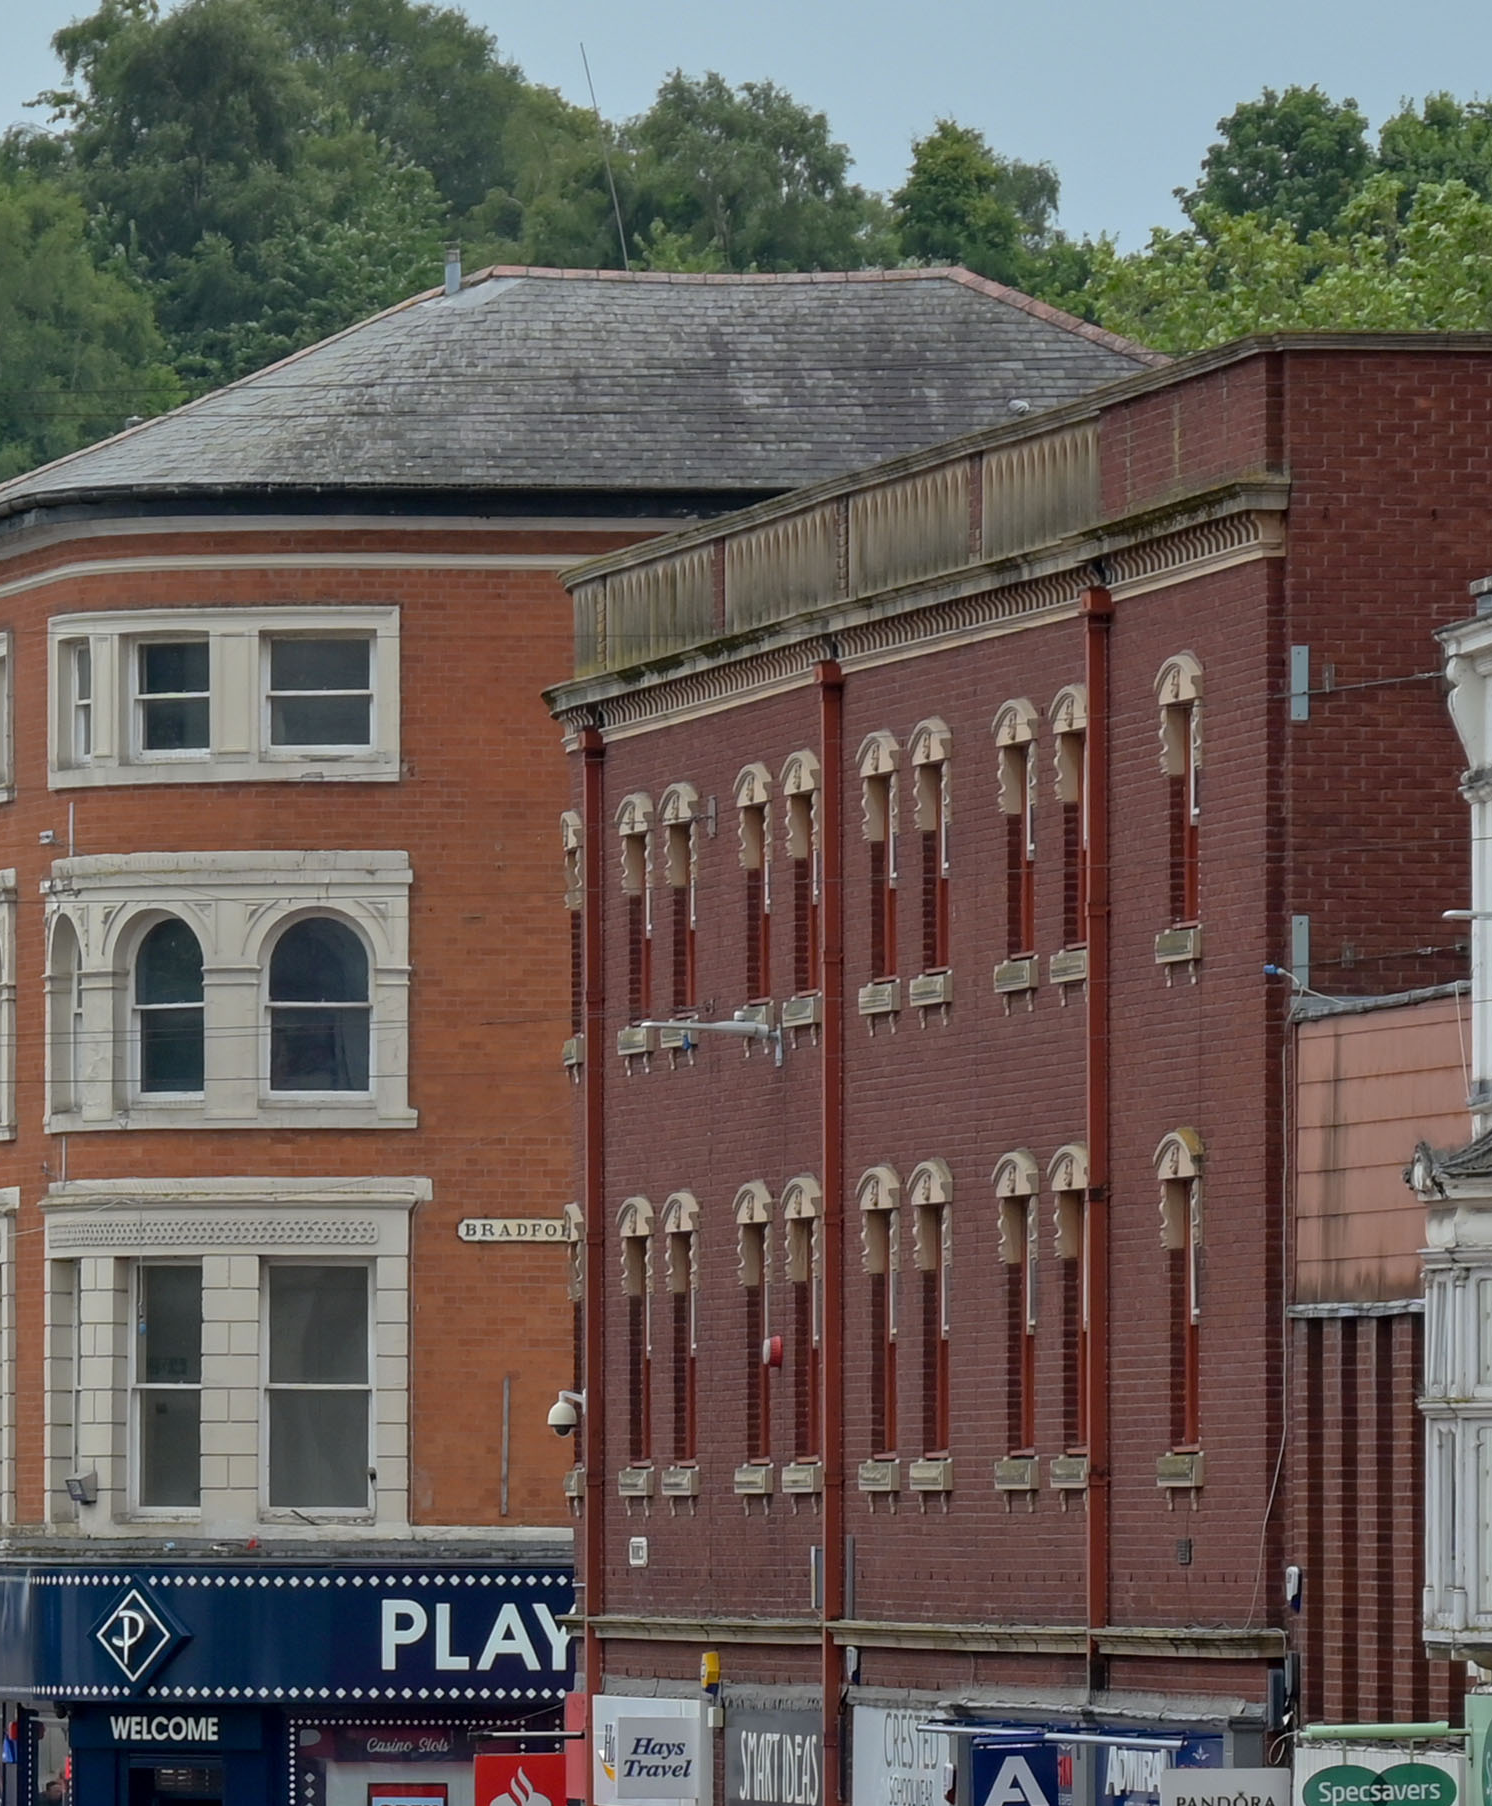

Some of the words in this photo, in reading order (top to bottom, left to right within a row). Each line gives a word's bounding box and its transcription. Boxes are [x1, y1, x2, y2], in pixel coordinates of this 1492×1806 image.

[110, 1716, 218, 1741] WELCOME
[884, 1712, 939, 1770] CRESTED
[366, 1738, 413, 1753] Casino
[417, 1737, 450, 1752] Slots
[631, 1737, 685, 1757] Hays
[624, 1759, 692, 1778] Travel
[740, 1730, 780, 1801] SMART
[782, 1733, 818, 1806] IDEAS
[1319, 1780, 1442, 1806] Specsavers
